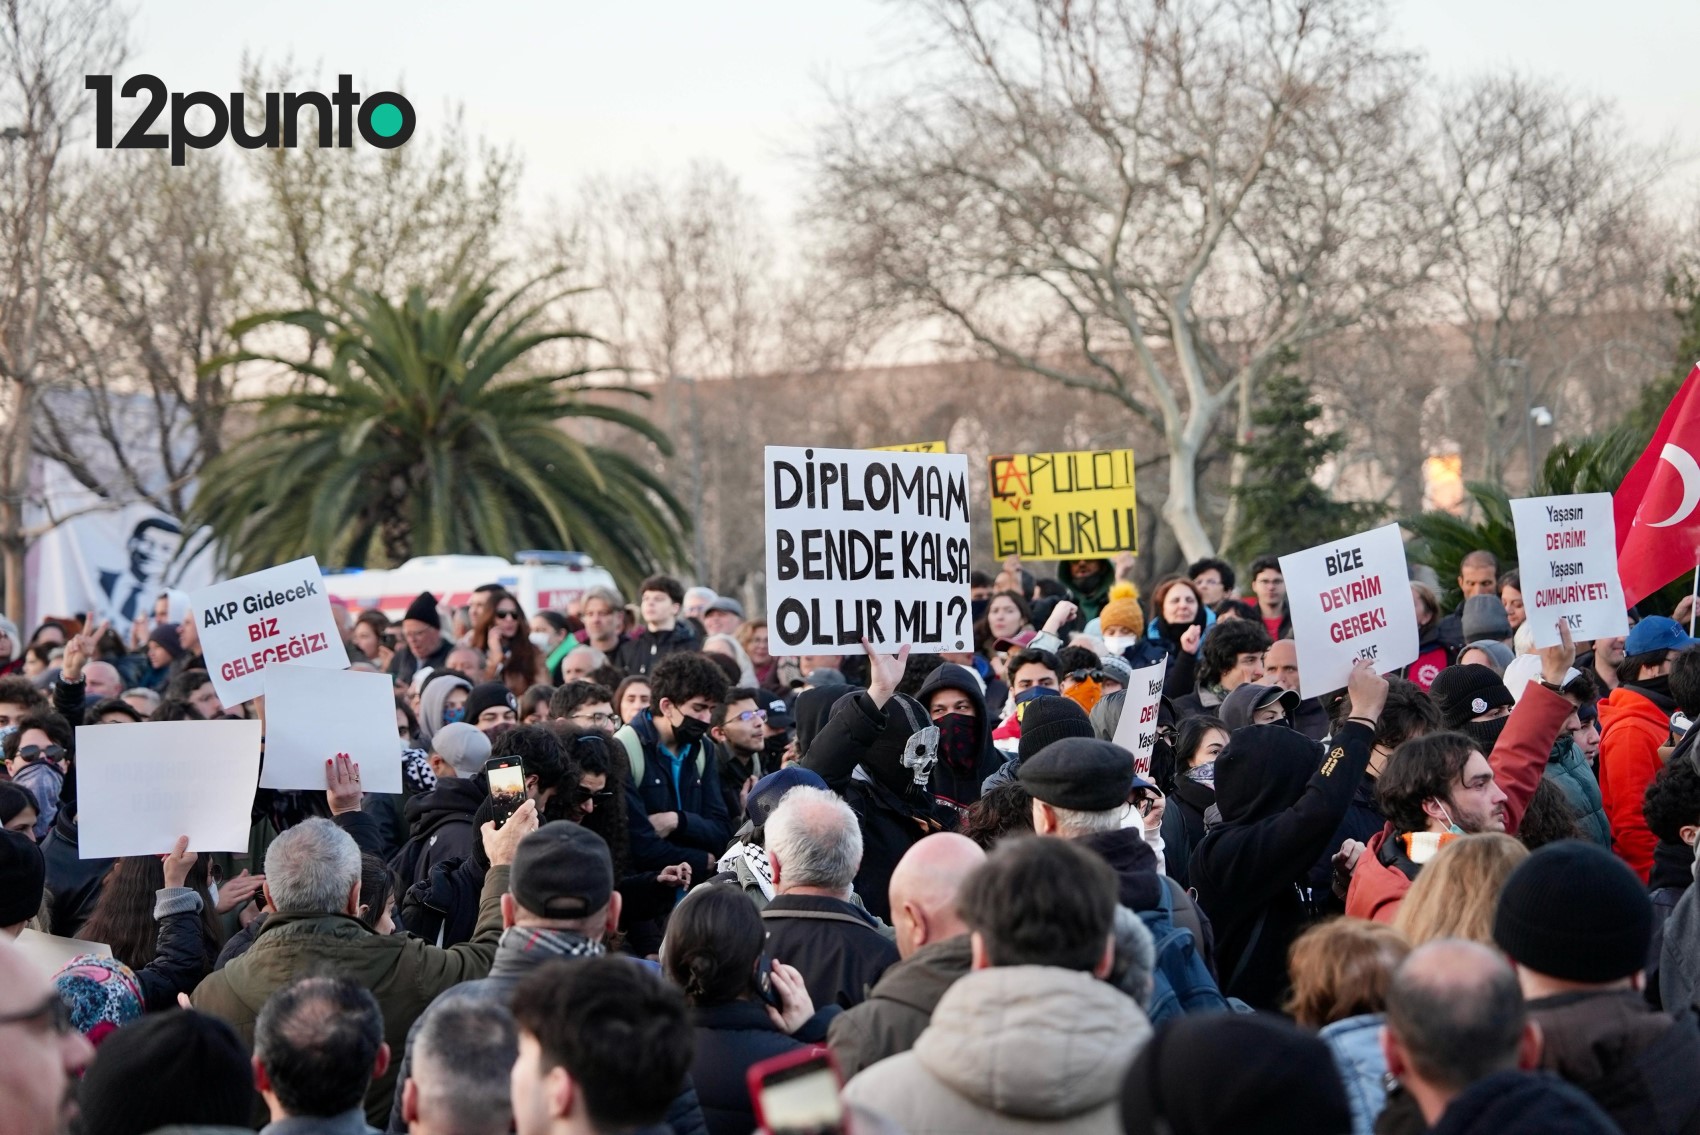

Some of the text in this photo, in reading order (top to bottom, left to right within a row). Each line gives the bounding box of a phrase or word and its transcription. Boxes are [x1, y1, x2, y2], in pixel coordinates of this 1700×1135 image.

[773, 449, 970, 523] DİPLOMAM
[1546, 505, 1583, 527] Yaşasın
[1546, 527, 1586, 550] DEVRİM!
[776, 528, 970, 584] BENDE KALSA
[1325, 547, 1364, 577] BİZE
[1550, 561, 1584, 582] Yaşasın
[204, 579, 318, 628] AKP Gidecek
[1319, 574, 1382, 613] DEVRİM
[1535, 581, 1608, 608] CUMHURİYET!
[248, 617, 280, 643] BİZ
[776, 595, 886, 646] OLUR
[1330, 607, 1387, 644] GEREK!
[1561, 614, 1583, 629] KF
[221, 632, 329, 682] GELECEĞİZ!
